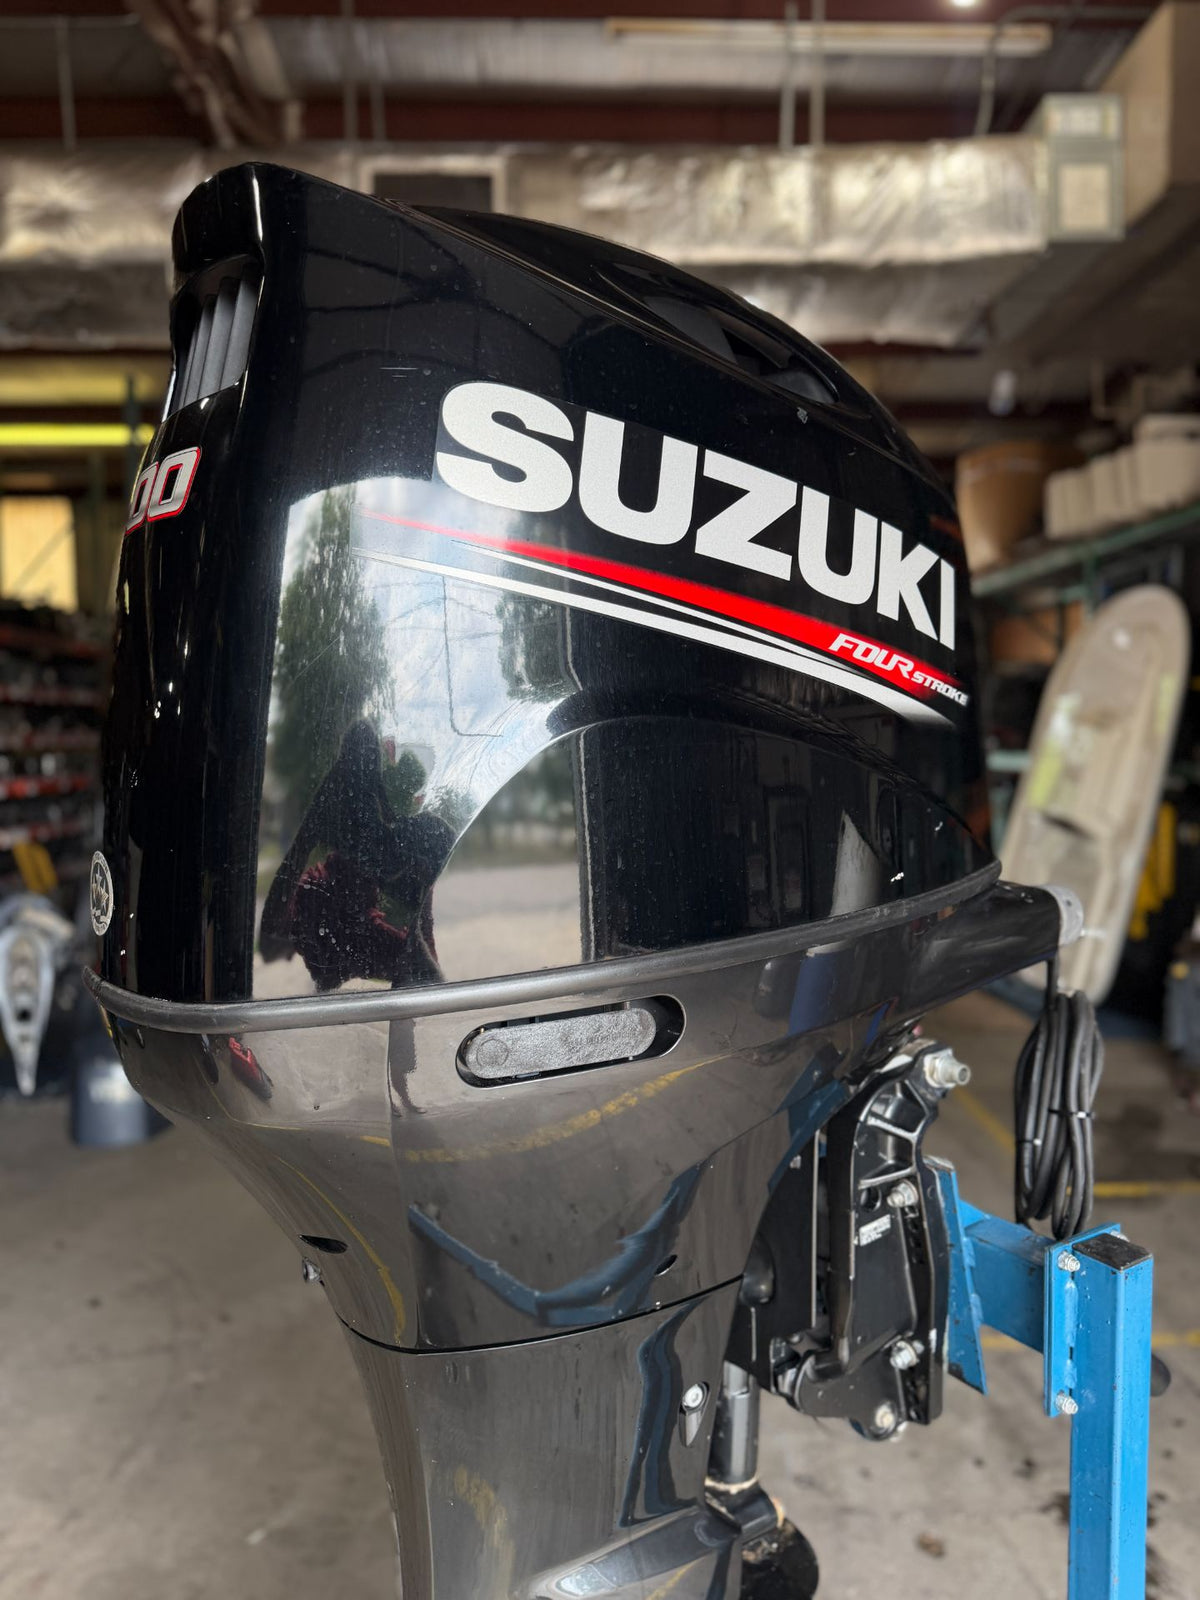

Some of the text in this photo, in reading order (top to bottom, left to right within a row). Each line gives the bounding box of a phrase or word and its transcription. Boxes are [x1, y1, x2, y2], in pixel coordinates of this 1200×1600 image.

[436, 381, 956, 651] SUZUKI
[828, 633, 969, 707] FOUR STROKE
